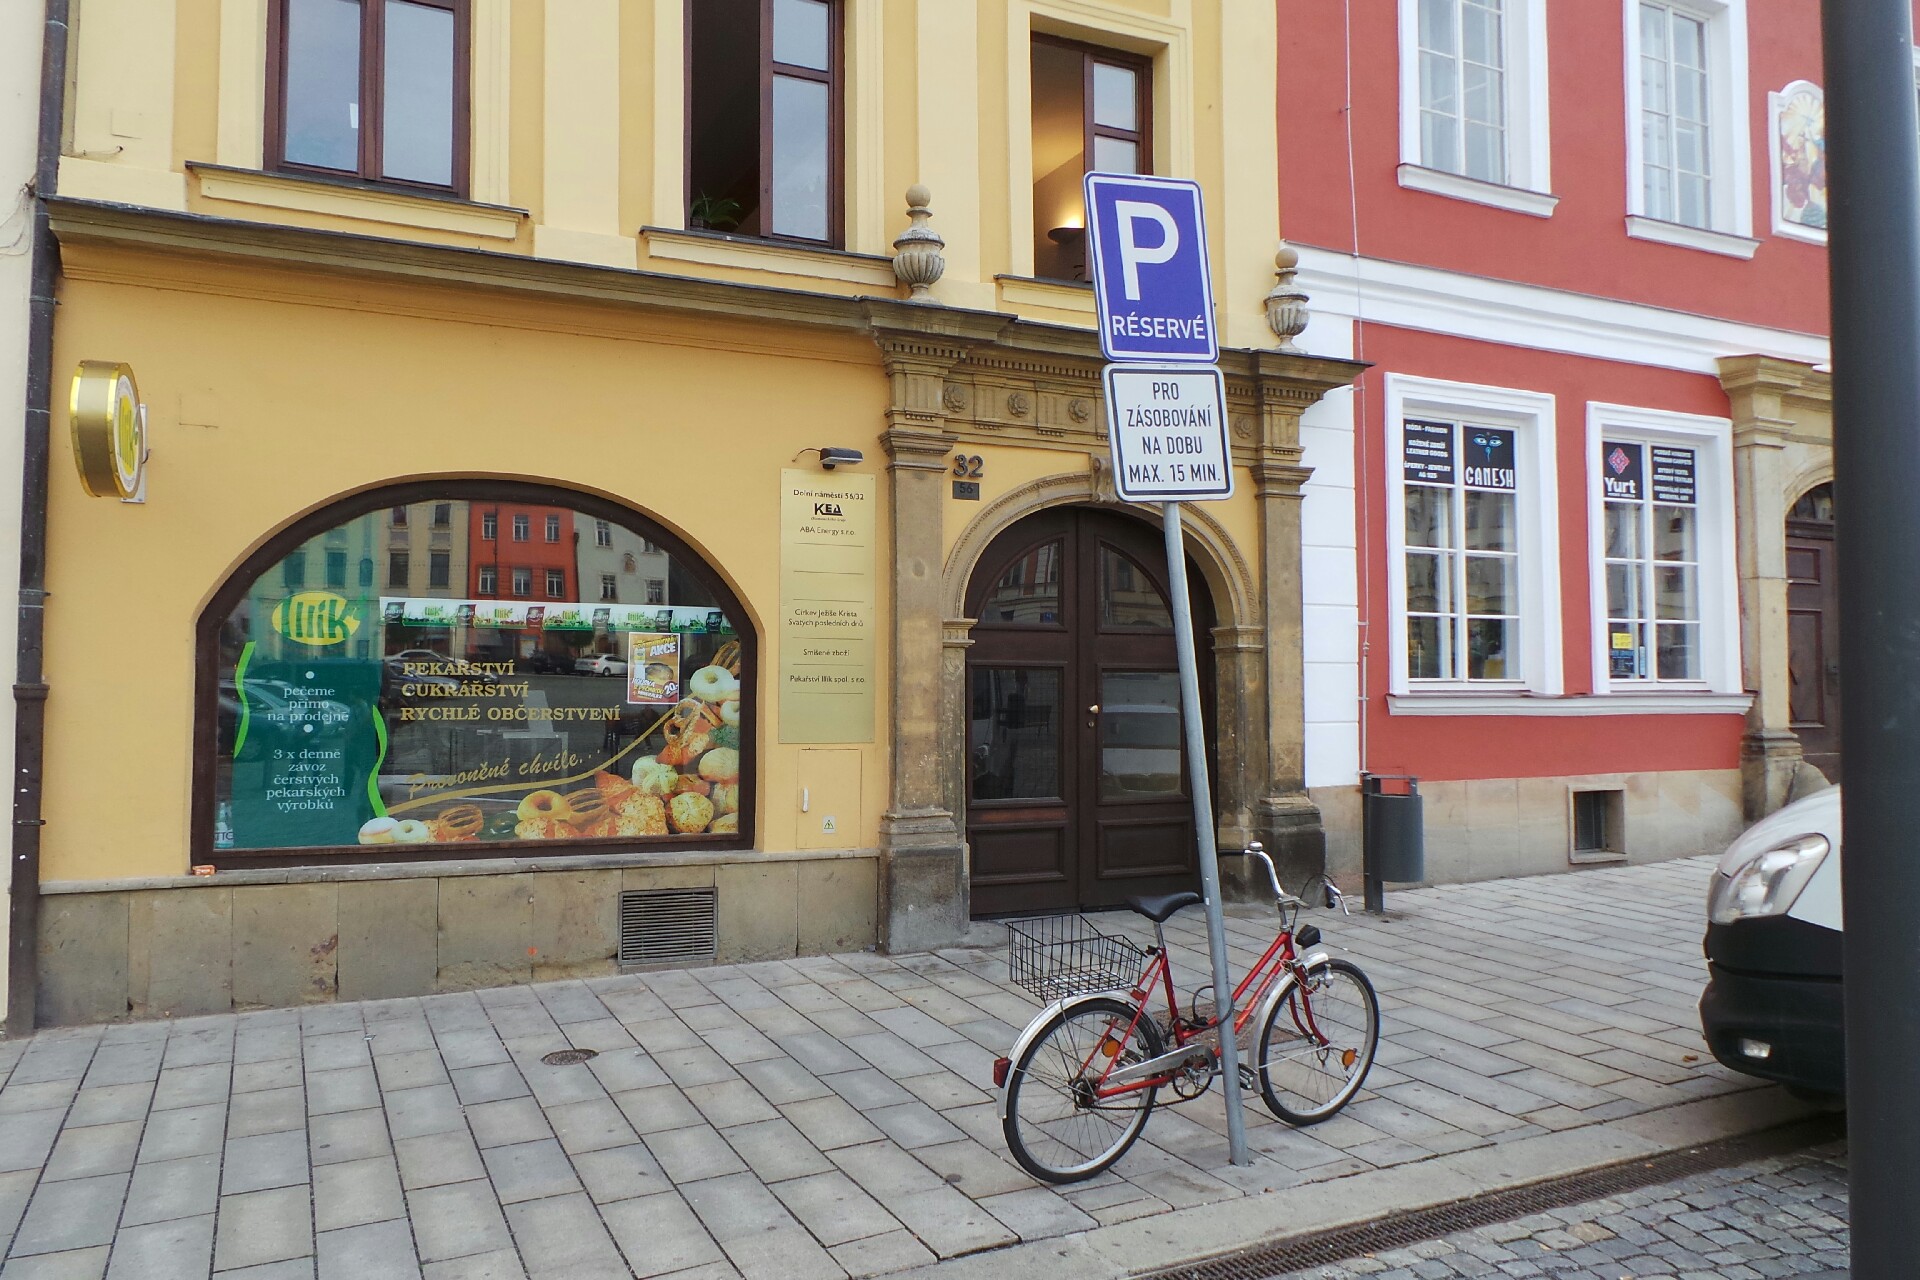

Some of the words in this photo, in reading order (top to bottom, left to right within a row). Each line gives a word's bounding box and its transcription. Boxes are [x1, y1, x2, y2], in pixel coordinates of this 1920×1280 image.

[1115, 200, 1179, 301] P
[1111, 311, 1206, 340] RÉSERVÉ
[1152, 382, 1179, 400] PRO
[1126, 405, 1212, 427] ZÁSOBOVÁNÍ
[1142, 436, 1161, 454] NA
[1166, 436, 1203, 454] DOBU
[953, 454, 983, 478] 32
[1128, 464, 1165, 483] MAX.
[1169, 464, 1185, 482] 15
[1190, 464, 1221, 482] MIN.
[1465, 466, 1514, 487] GANESH
[793, 489, 813, 497] Dolní
[959, 482, 974, 494] 56
[1604, 477, 1636, 494] Yurt
[814, 502, 843, 516] KEA
[650, 642, 676, 656] AKCE
[283, 685, 336, 699] pečeme
[401, 679, 529, 698] CUKRÁŘSTVÍ
[289, 698, 330, 711] přímo
[400, 703, 481, 721] RYCHLÉ
[486, 704, 621, 721] OBČERSTVENÍ
[267, 712, 286, 721] na
[289, 711, 350, 725] prodejně
[273, 748, 283, 760] 3
[286, 751, 296, 759] x
[299, 748, 341, 759] denně
[288, 761, 327, 772] závoz
[273, 773, 340, 787] čerstvých
[265, 786, 346, 801] pekařských
[276, 798, 335, 814] výrobků
